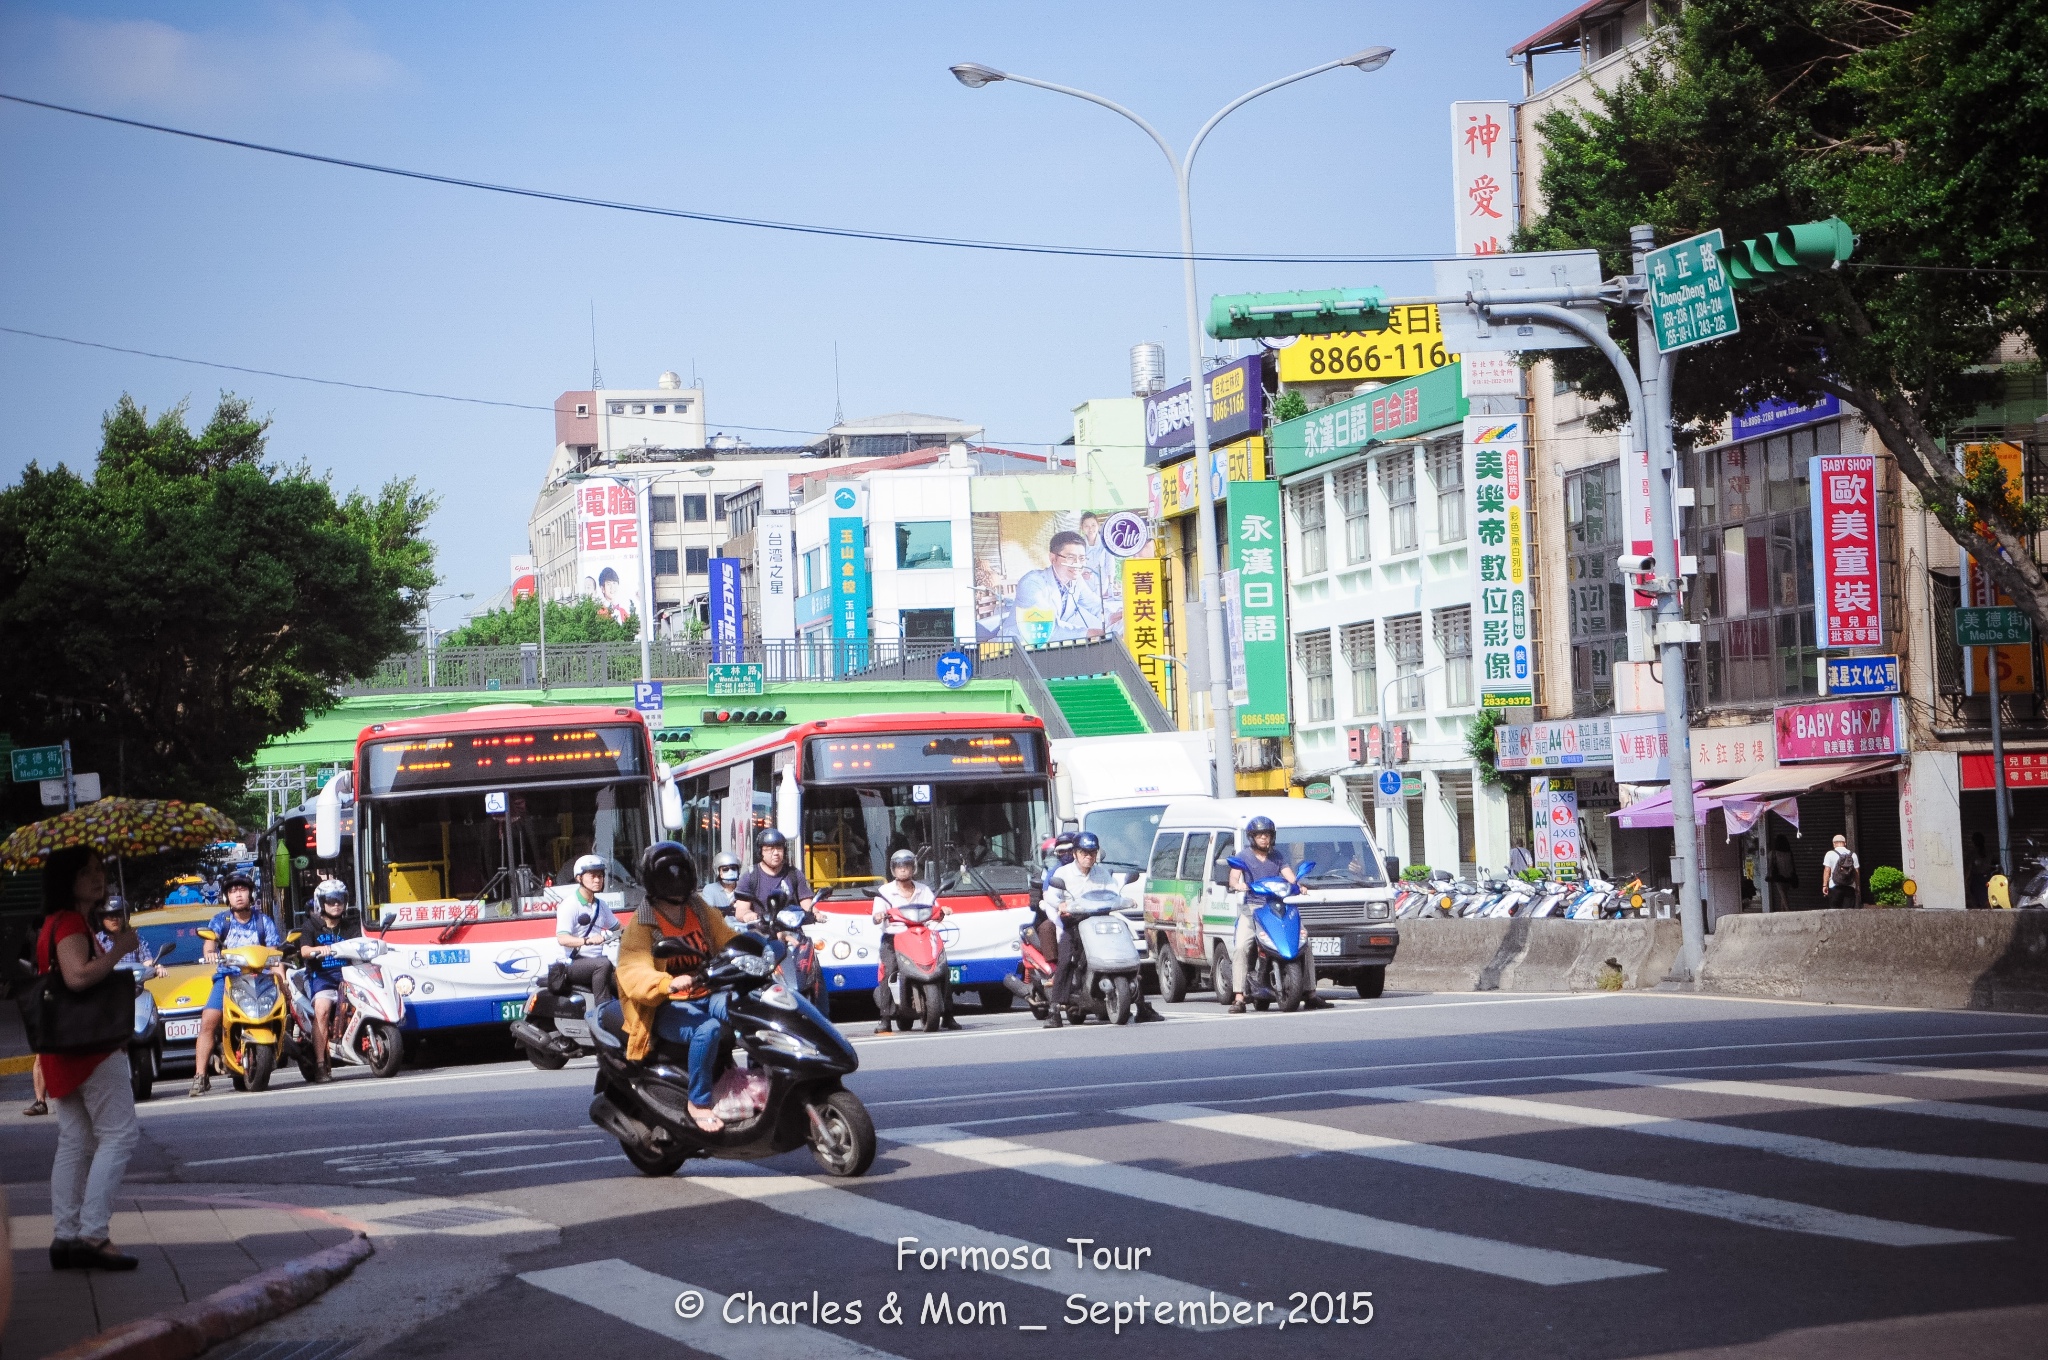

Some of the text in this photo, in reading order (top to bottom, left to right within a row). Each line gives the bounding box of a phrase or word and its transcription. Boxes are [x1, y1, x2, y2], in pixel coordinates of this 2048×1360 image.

[1654, 241, 1717, 287] 中正路
[1659, 275, 1721, 308] ZhongZheng Rd.
[1304, 402, 1367, 458] 永漢日語
[1228, 450, 1246, 481] 日文
[1507, 453, 1519, 496] 沖洗照片
[1821, 458, 1873, 472] BABY SHOP
[585, 485, 637, 517] 電腦
[1163, 474, 1178, 509] 多益
[586, 518, 639, 551] 巨匠
[1111, 520, 1140, 548] Elite
[1828, 473, 1871, 613] 歐美童裝
[840, 529, 856, 594] 玉山金控
[1475, 450, 1512, 680] 美樂帝數位影像
[1240, 513, 1279, 643] 永漢日語
[721, 563, 737, 663] SKECHE
[1513, 594, 1525, 638] 文件輸出
[1829, 615, 1879, 628] 嬰兒服
[1963, 610, 2024, 628] 美德街
[1830, 628, 1880, 642] 批發零售
[1969, 628, 2022, 641] MeiDe St.
[714, 665, 759, 676] 文林路
[1516, 651, 1526, 675] 裝訂
[1827, 663, 1898, 687] 漢星文化公司
[1483, 696, 1532, 706] 2832-9372
[1241, 713, 1287, 726] 8866-5995
[1796, 711, 1834, 739] BABY
[1549, 728, 1562, 751] A4
[1823, 736, 1891, 754] 歐美童裝 批發零售
[1699, 740, 1766, 765] 永鈺銀樓
[1549, 779, 1574, 790] 沖洗
[1551, 793, 1574, 803] 3X5
[1535, 811, 1548, 828] A4
[1552, 828, 1576, 838] 4X6
[398, 904, 479, 922] 兒童新樂園
